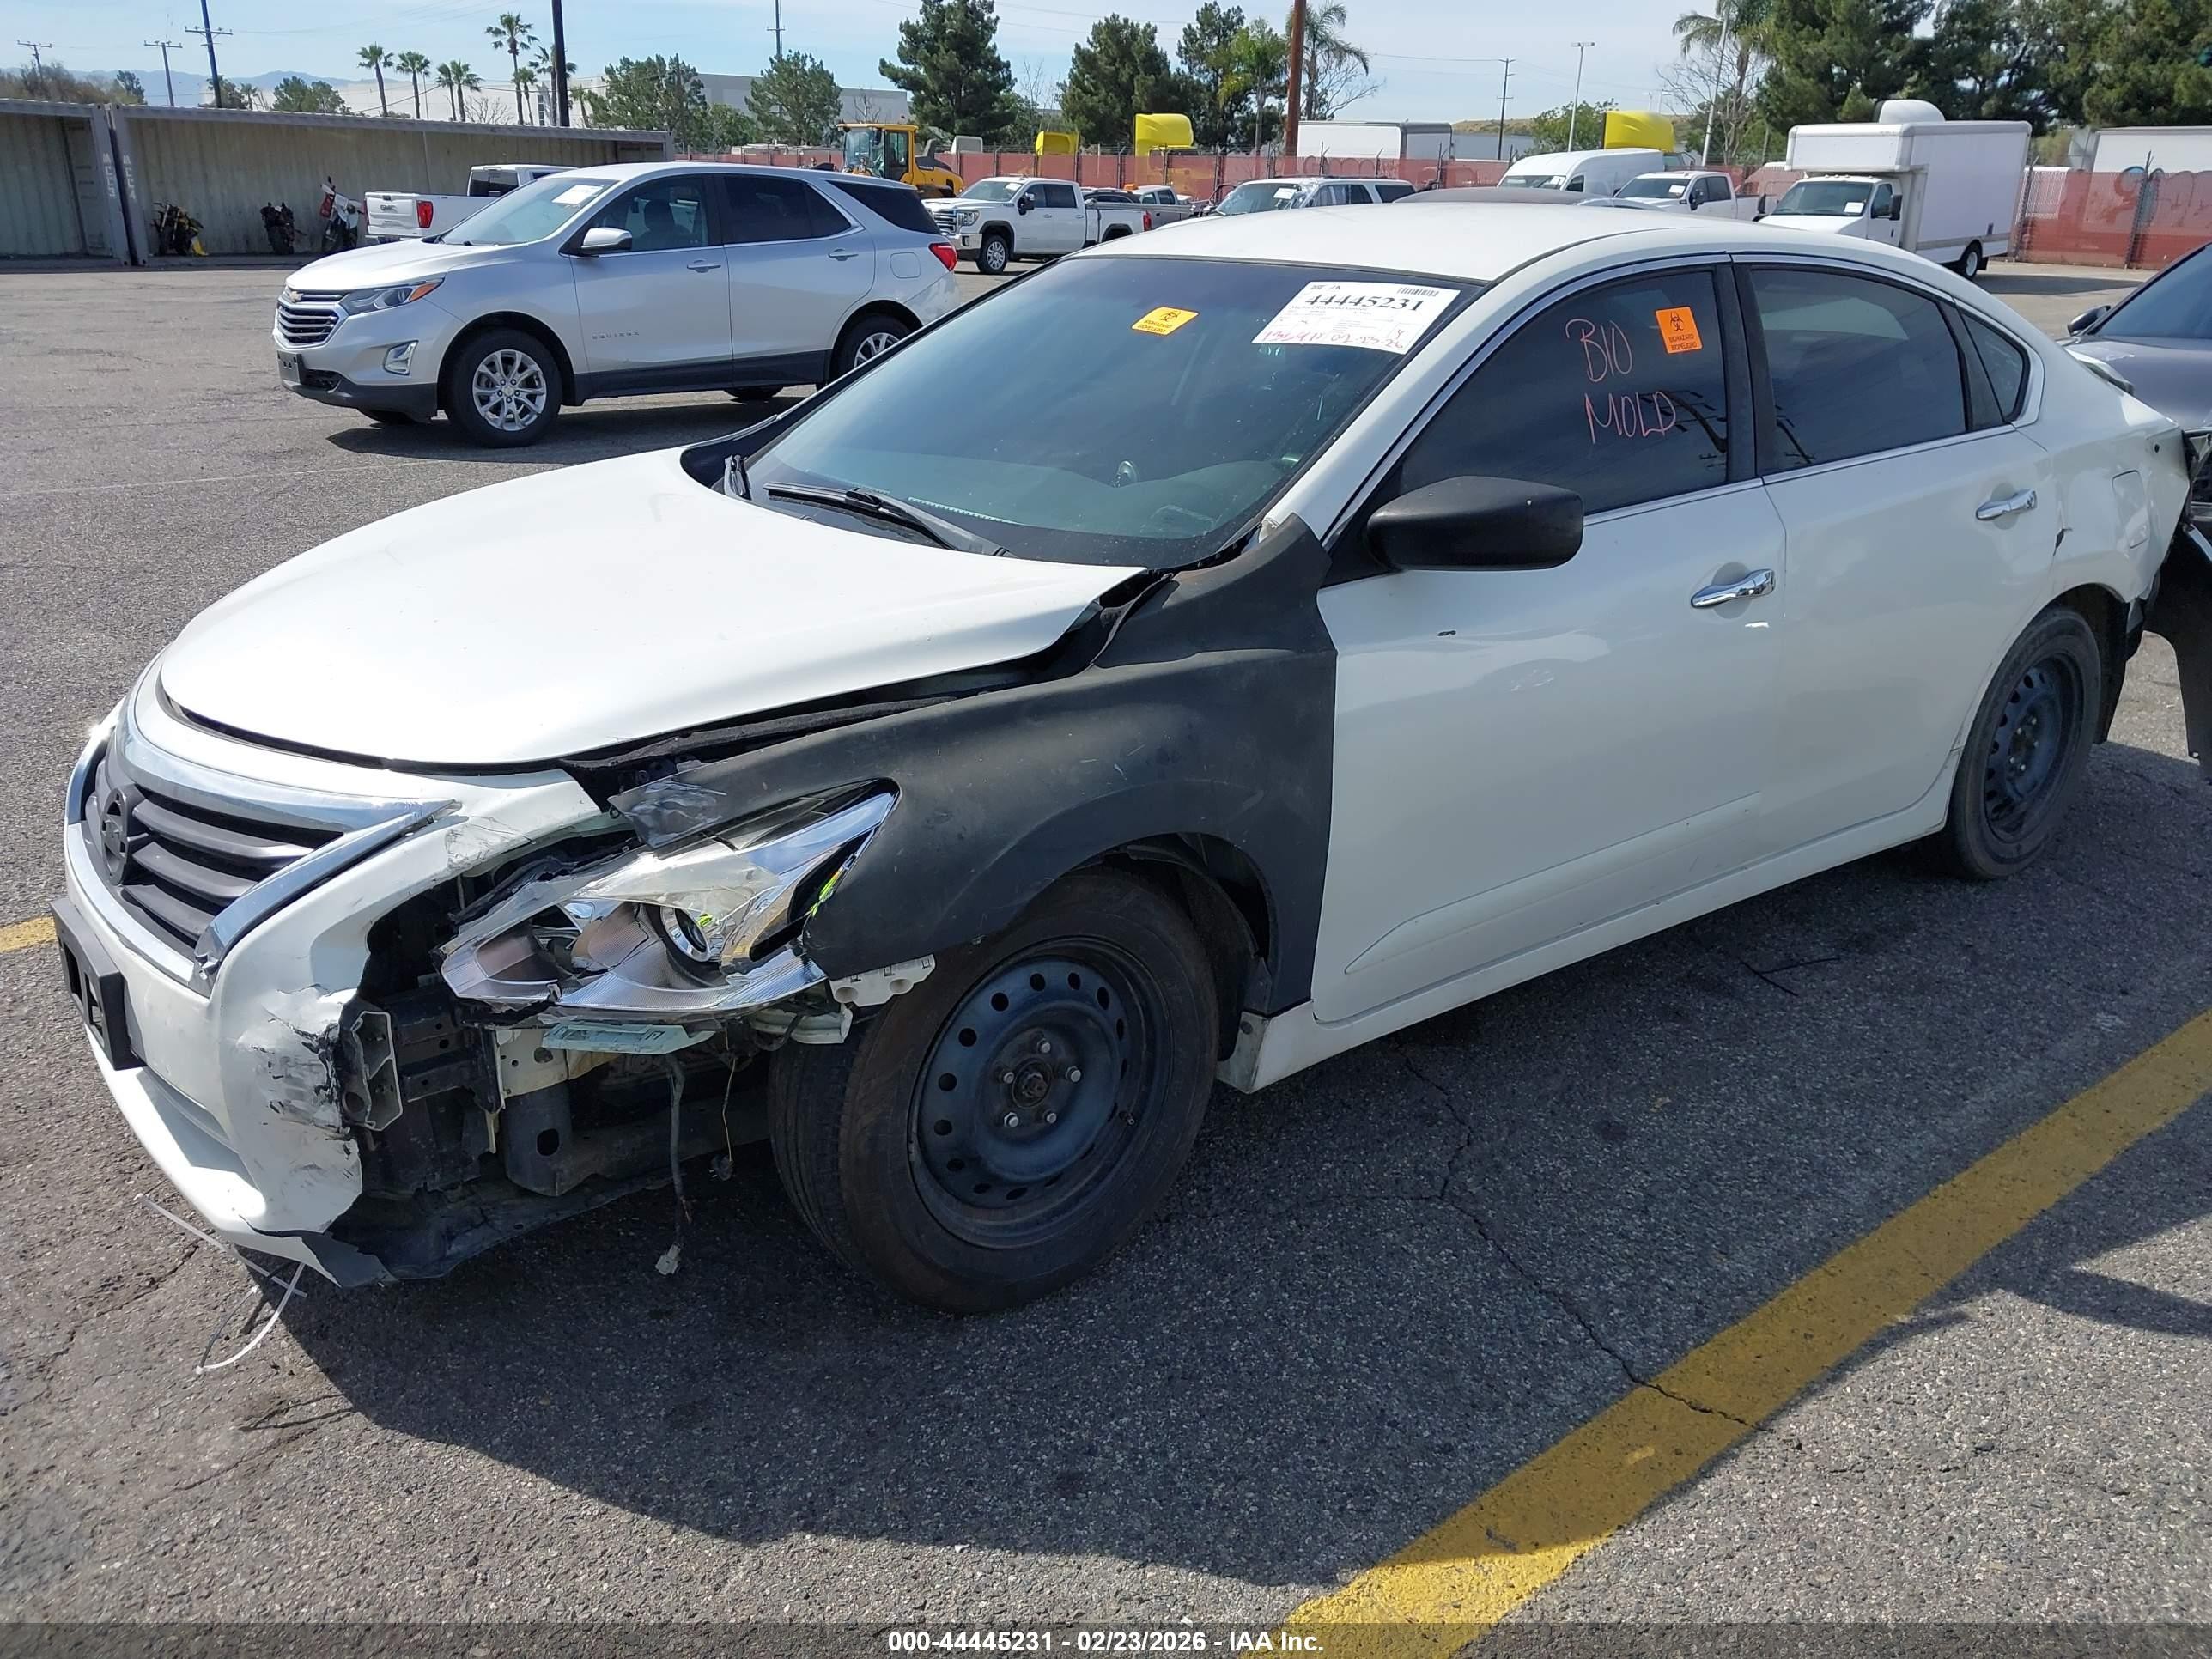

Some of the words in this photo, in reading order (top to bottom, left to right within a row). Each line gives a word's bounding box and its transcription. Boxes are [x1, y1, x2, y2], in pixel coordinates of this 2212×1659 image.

[1305, 294, 1425, 312] 44445231
[1565, 318, 1632, 383] BIO
[1668, 333, 1694, 343] BIOHAZARD
[1584, 391, 1676, 444] MOLD
